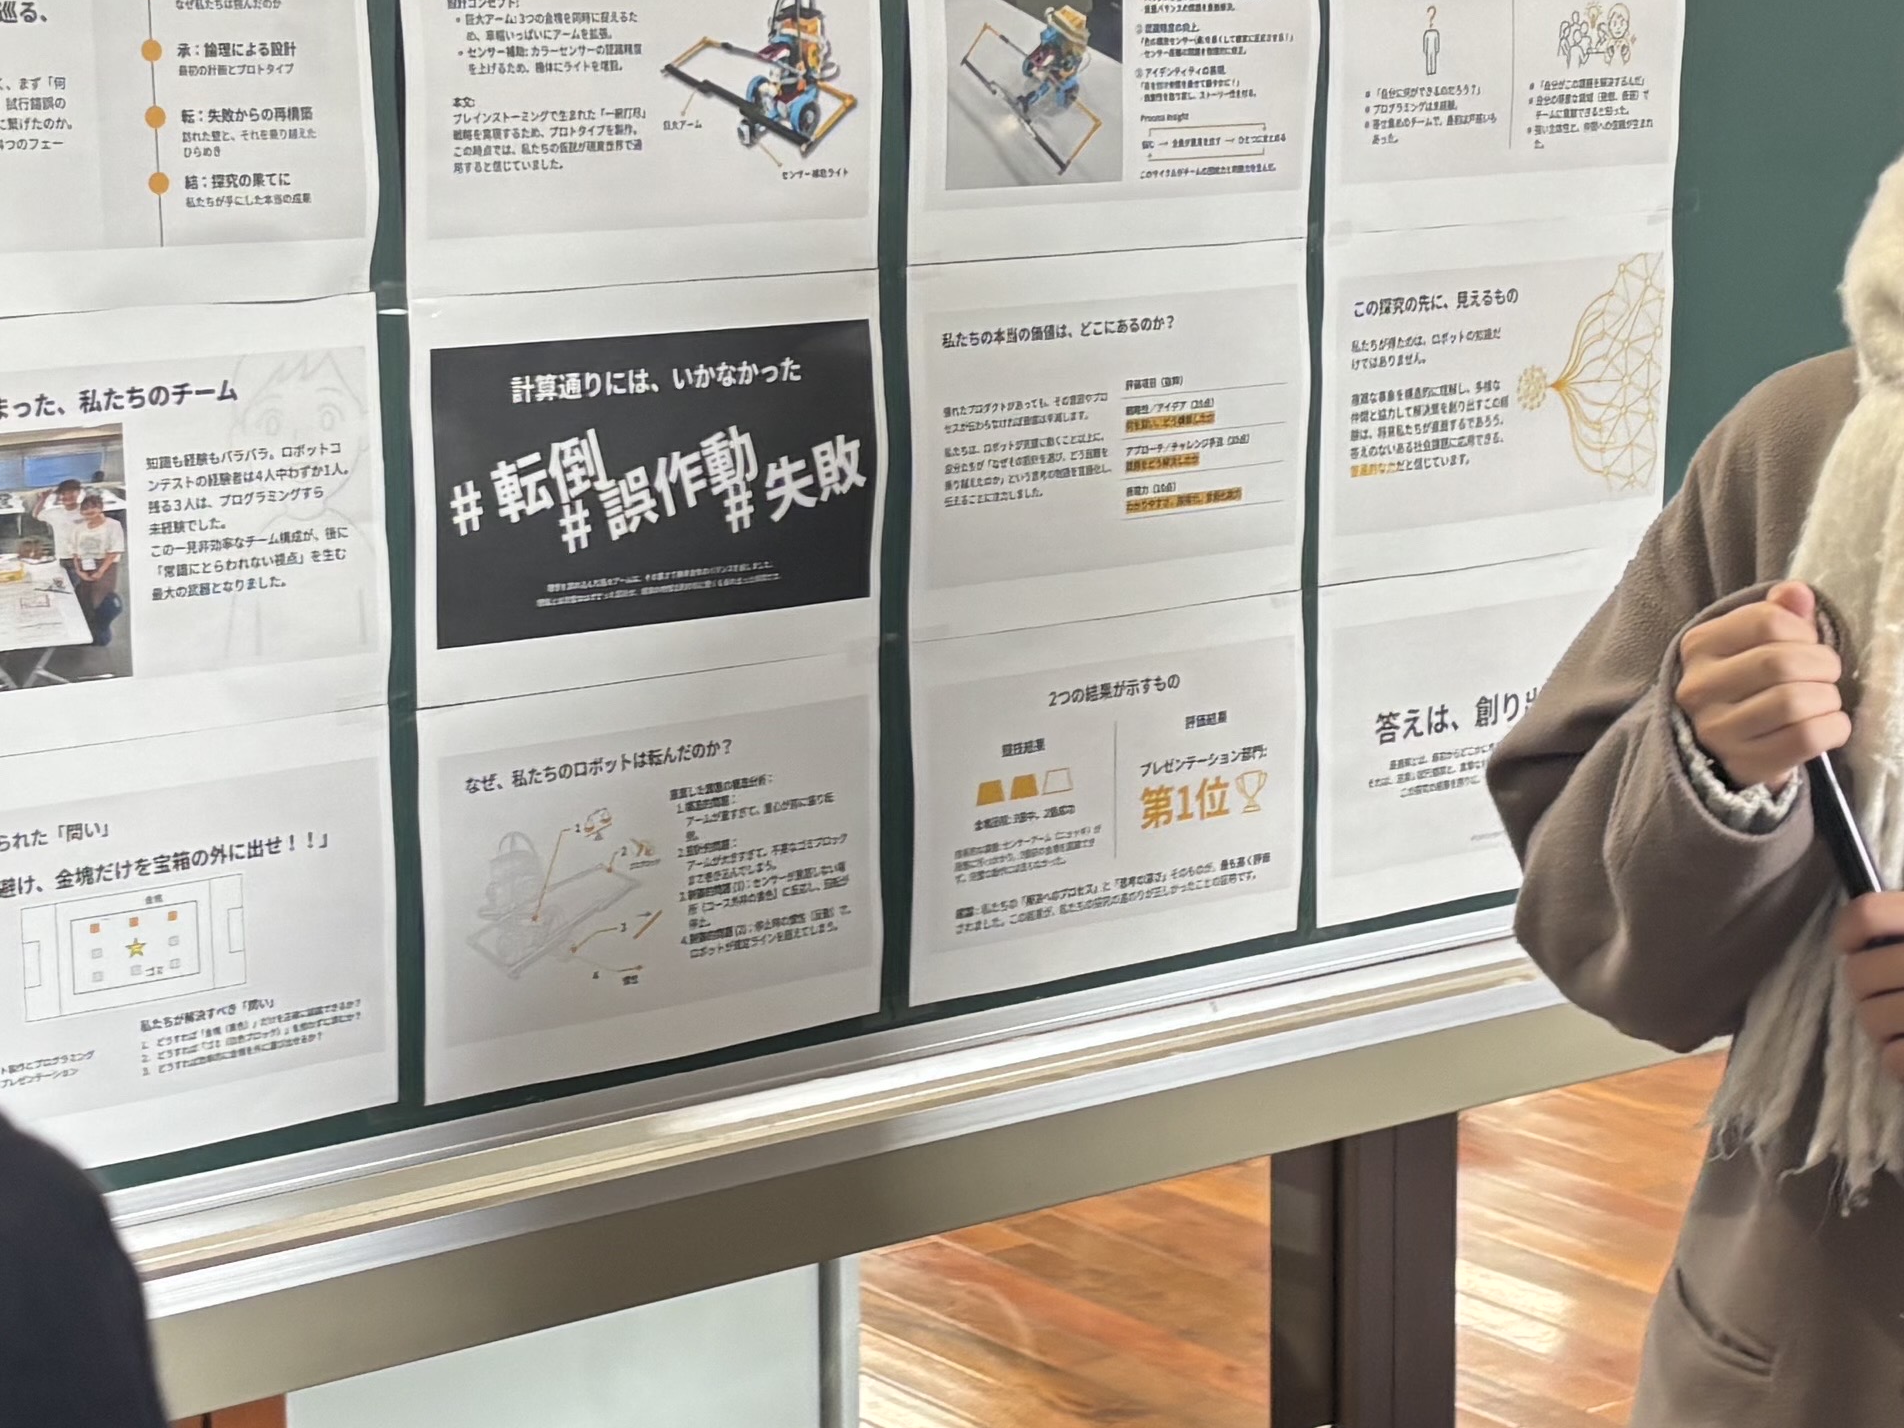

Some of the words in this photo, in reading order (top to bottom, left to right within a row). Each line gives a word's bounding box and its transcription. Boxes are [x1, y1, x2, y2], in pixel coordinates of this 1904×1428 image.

[178, 42, 296, 58] 承：論理による設計
[182, 106, 312, 123] 転：失敗からの再構築
[184, 146, 220, 158] ひらめき
[185, 173, 290, 189] 結：探究の果てに
[1354, 288, 1518, 317] この探究の先に、見えるもの
[942, 315, 1174, 348] 私たちの本当の価値は、どこにあるのか？
[511, 357, 801, 403] 計算通りには、いかなかった
[149, 518, 225, 535] 未経験でした。
[1049, 674, 1180, 707] 2つの結果が示すもの
[466, 739, 732, 793] なぜ、私たちのロボットは転んだのか？
[1141, 777, 1229, 829] 第1位
